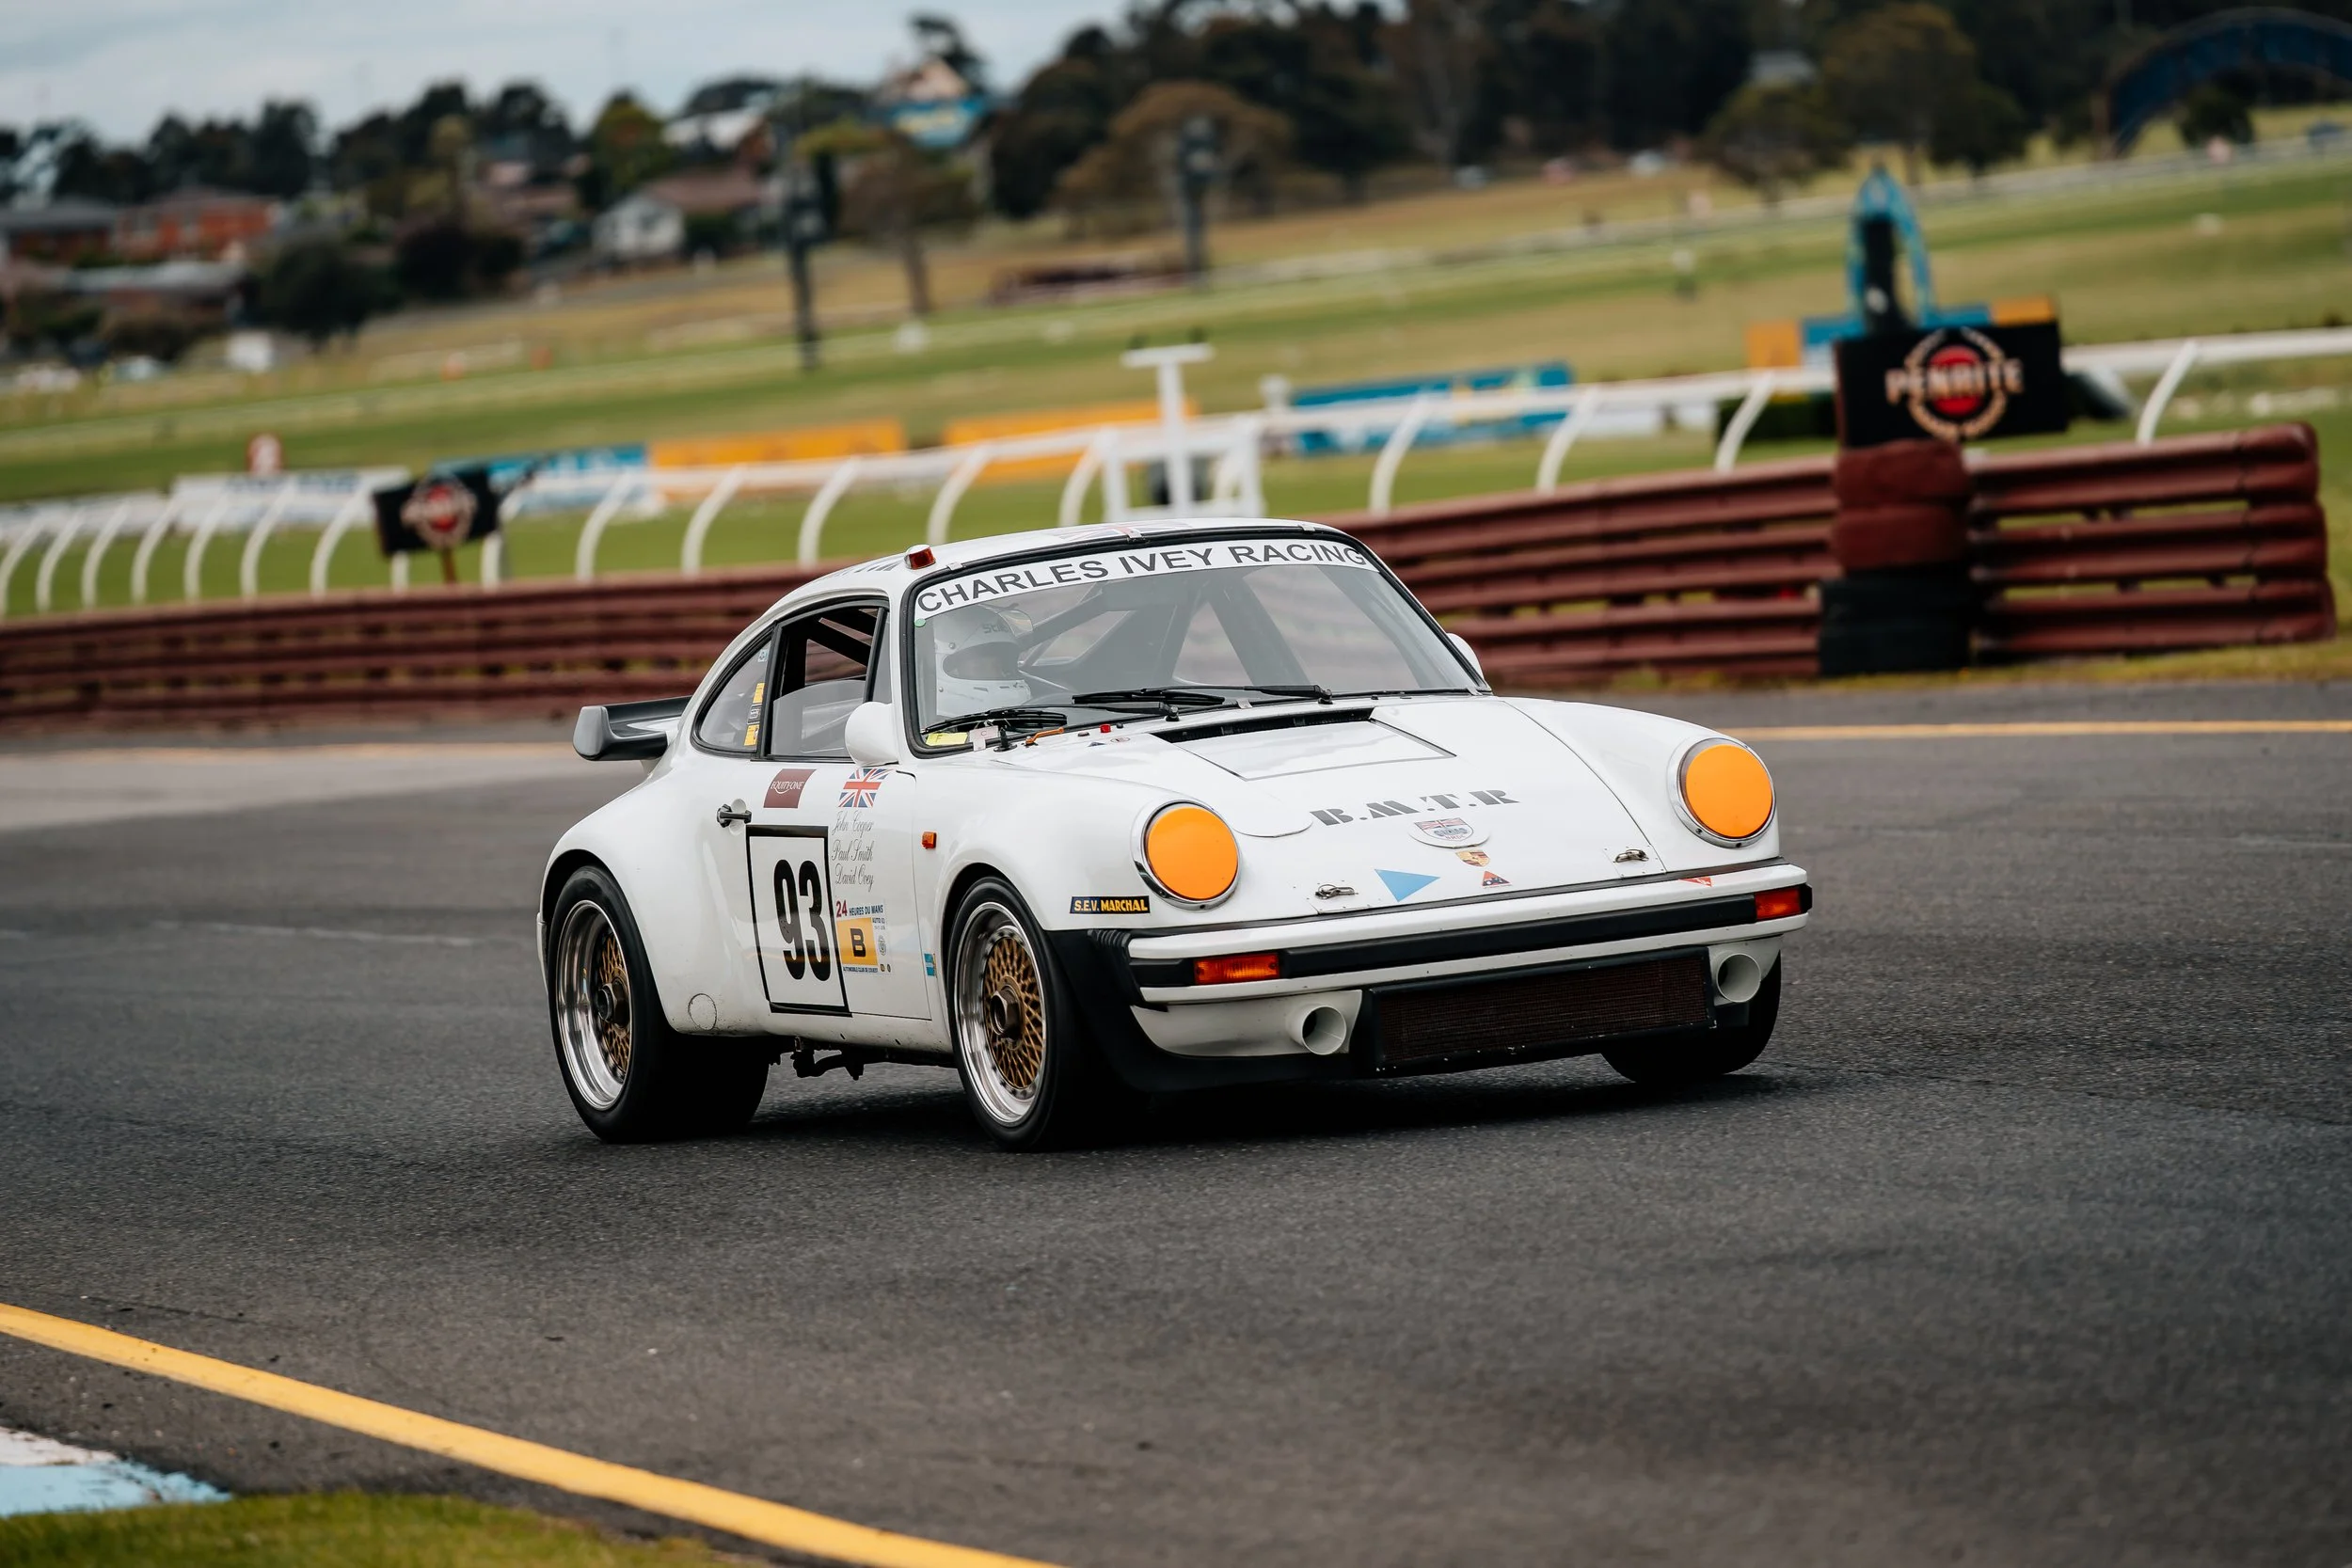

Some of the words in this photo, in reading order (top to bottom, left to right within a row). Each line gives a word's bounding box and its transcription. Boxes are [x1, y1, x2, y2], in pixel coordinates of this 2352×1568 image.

[1884, 358, 2022, 404] PENRITE
[917, 560, 1109, 611] CHARLES
[1118, 547, 1214, 574] IVEY
[1227, 544, 1367, 565] RACING
[832, 810, 849, 835] John
[832, 839, 853, 861] Paul
[851, 839, 875, 861] Smith
[835, 863, 858, 884] David
[836, 900, 847, 917] 24
[850, 907, 864, 915] HEURES
[865, 906, 870, 914] DU
[871, 905, 882, 913] MANS
[1073, 899, 1100, 911] S.E.V.
[1100, 898, 1148, 911] MARCHAL
[773, 859, 831, 981] 93
[850, 928, 866, 957] B
